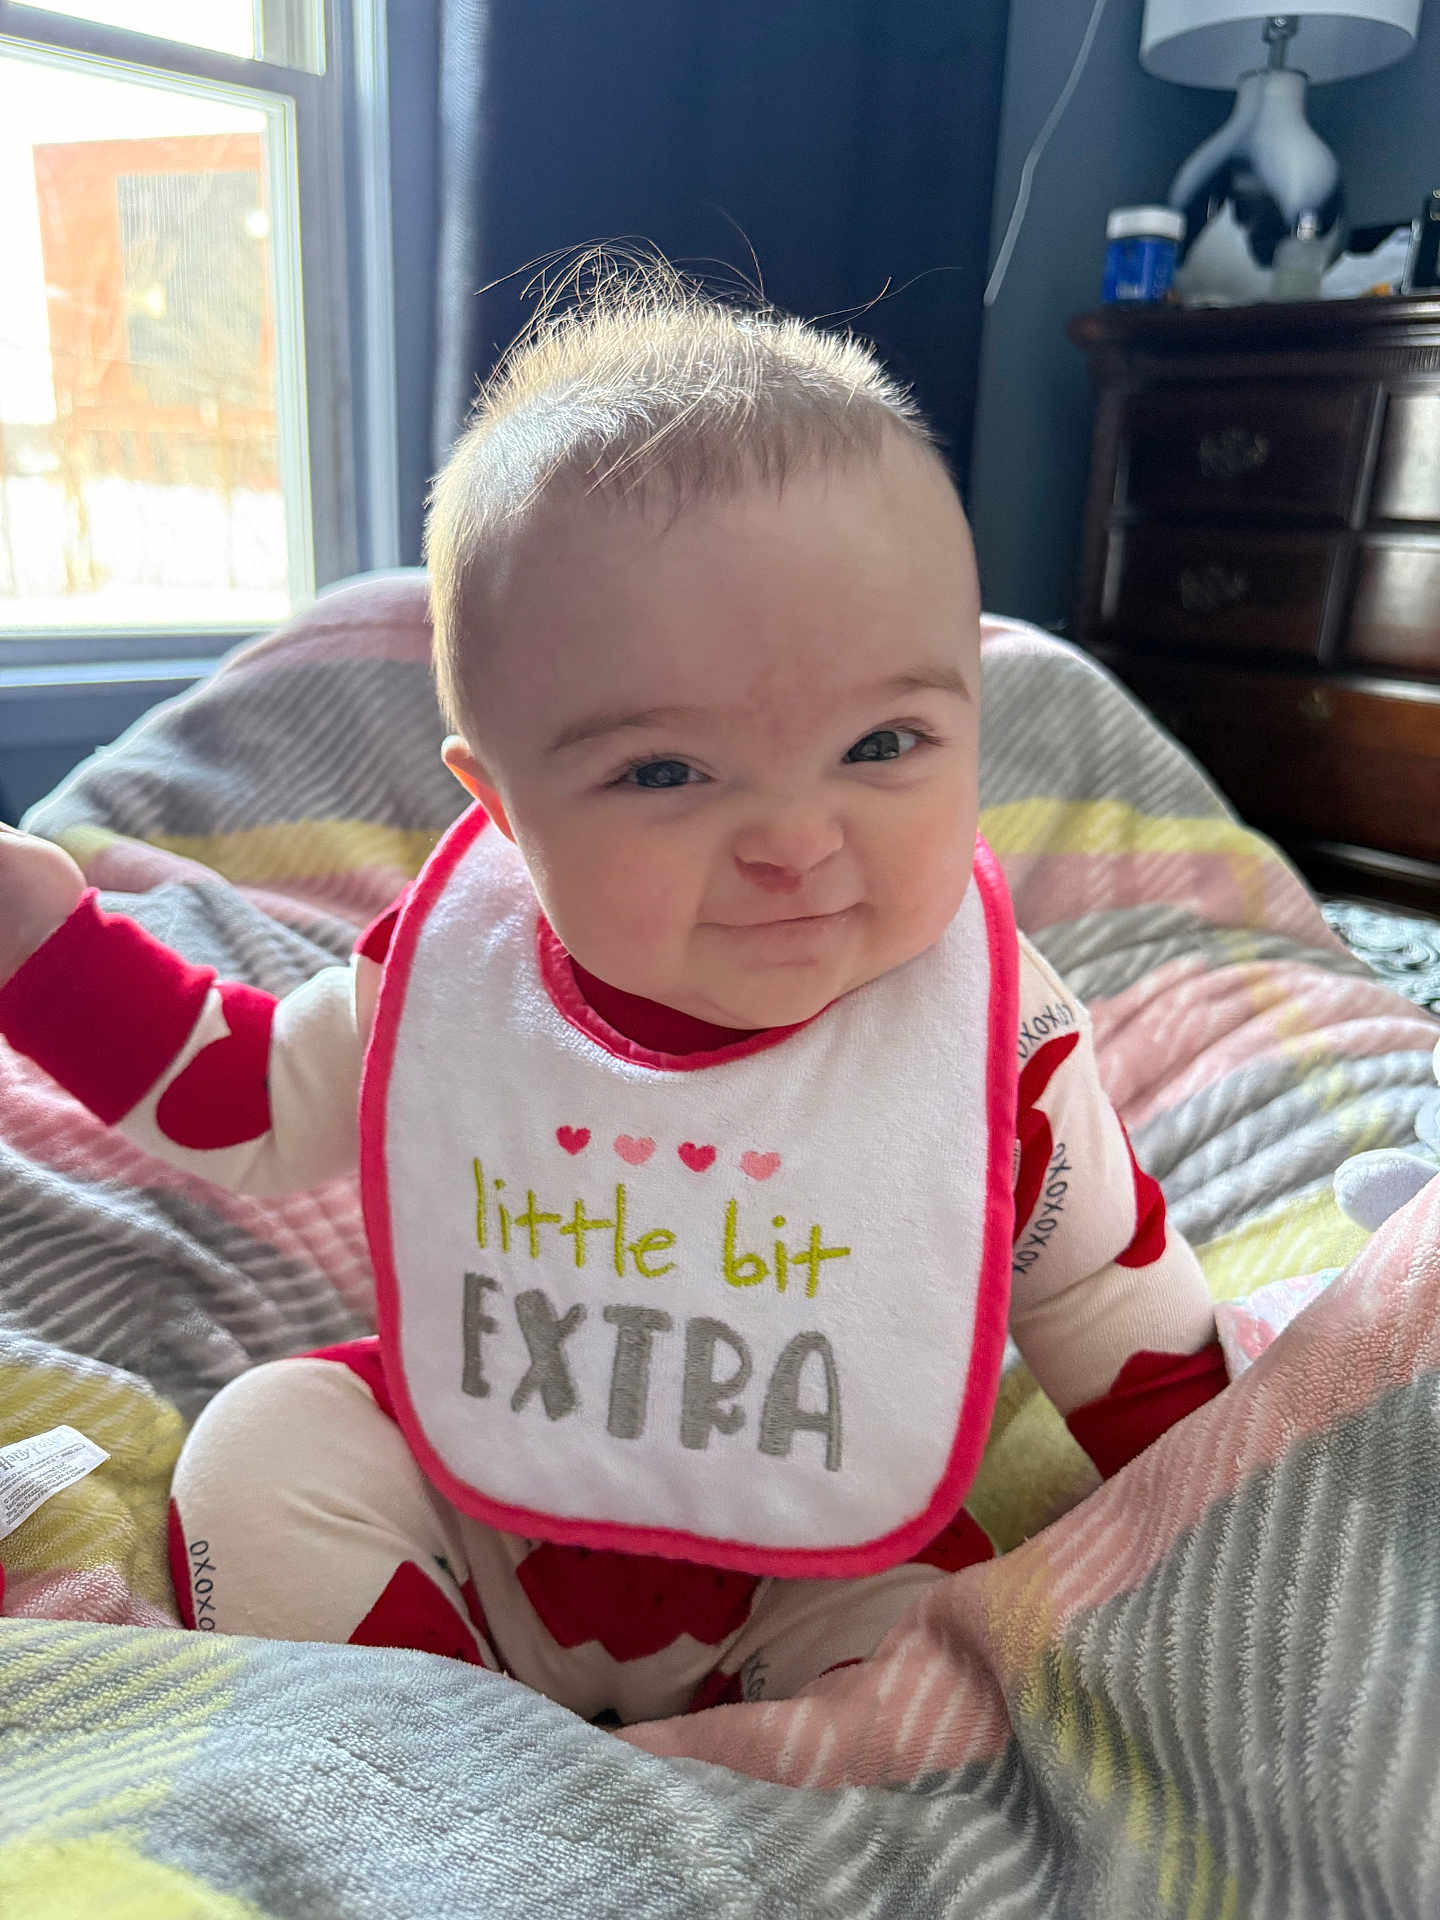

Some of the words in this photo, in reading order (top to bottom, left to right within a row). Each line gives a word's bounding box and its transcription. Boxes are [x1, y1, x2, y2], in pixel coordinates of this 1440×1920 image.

[474, 1157, 676, 1277] little
[723, 1198, 851, 1298] bit
[461, 1272, 842, 1472] EXTRA
